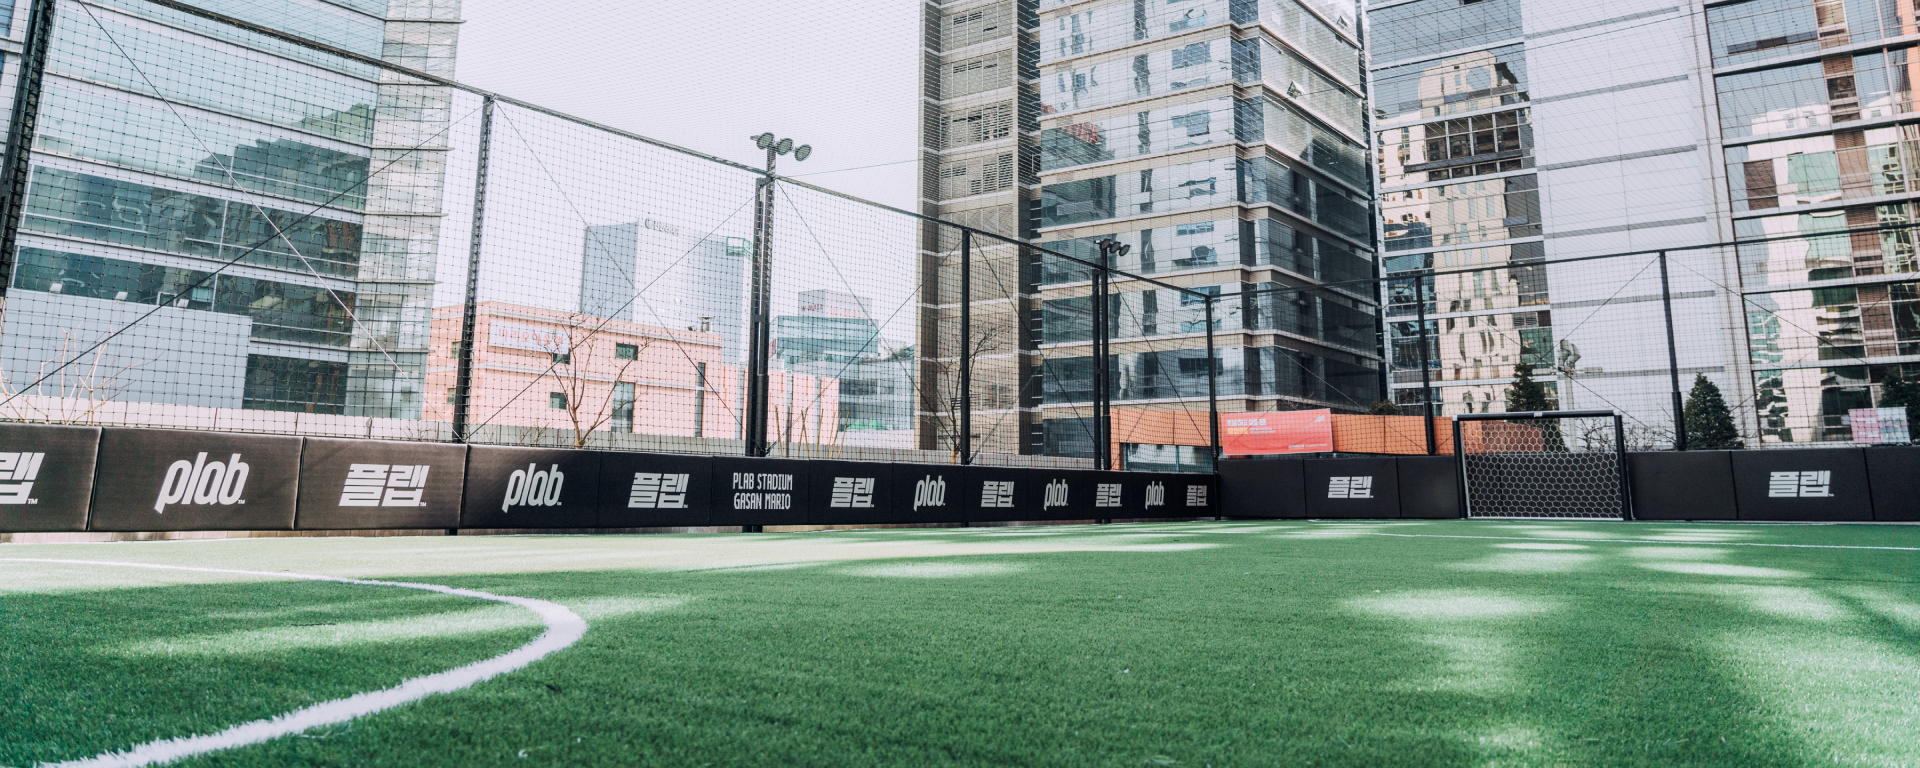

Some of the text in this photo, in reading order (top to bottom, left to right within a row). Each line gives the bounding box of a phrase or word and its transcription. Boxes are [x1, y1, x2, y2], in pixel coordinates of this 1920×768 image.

[154, 452, 249, 514] plab
[339, 464, 430, 506] 플랩
[501, 463, 564, 513] plab
[628, 473, 689, 508] 플랩
[733, 472, 793, 491] PLAB STADIUM
[831, 477, 874, 507] 플랩
[914, 474, 946, 511] plab
[981, 481, 1014, 507] 플랩
[1044, 479, 1068, 511] plab
[1096, 484, 1122, 507] 플랩
[1145, 481, 1165, 510] plab
[1328, 476, 1373, 498] 플랩
[1769, 470, 1834, 497] 플랩
[734, 492, 791, 510] GASAN MARIO
